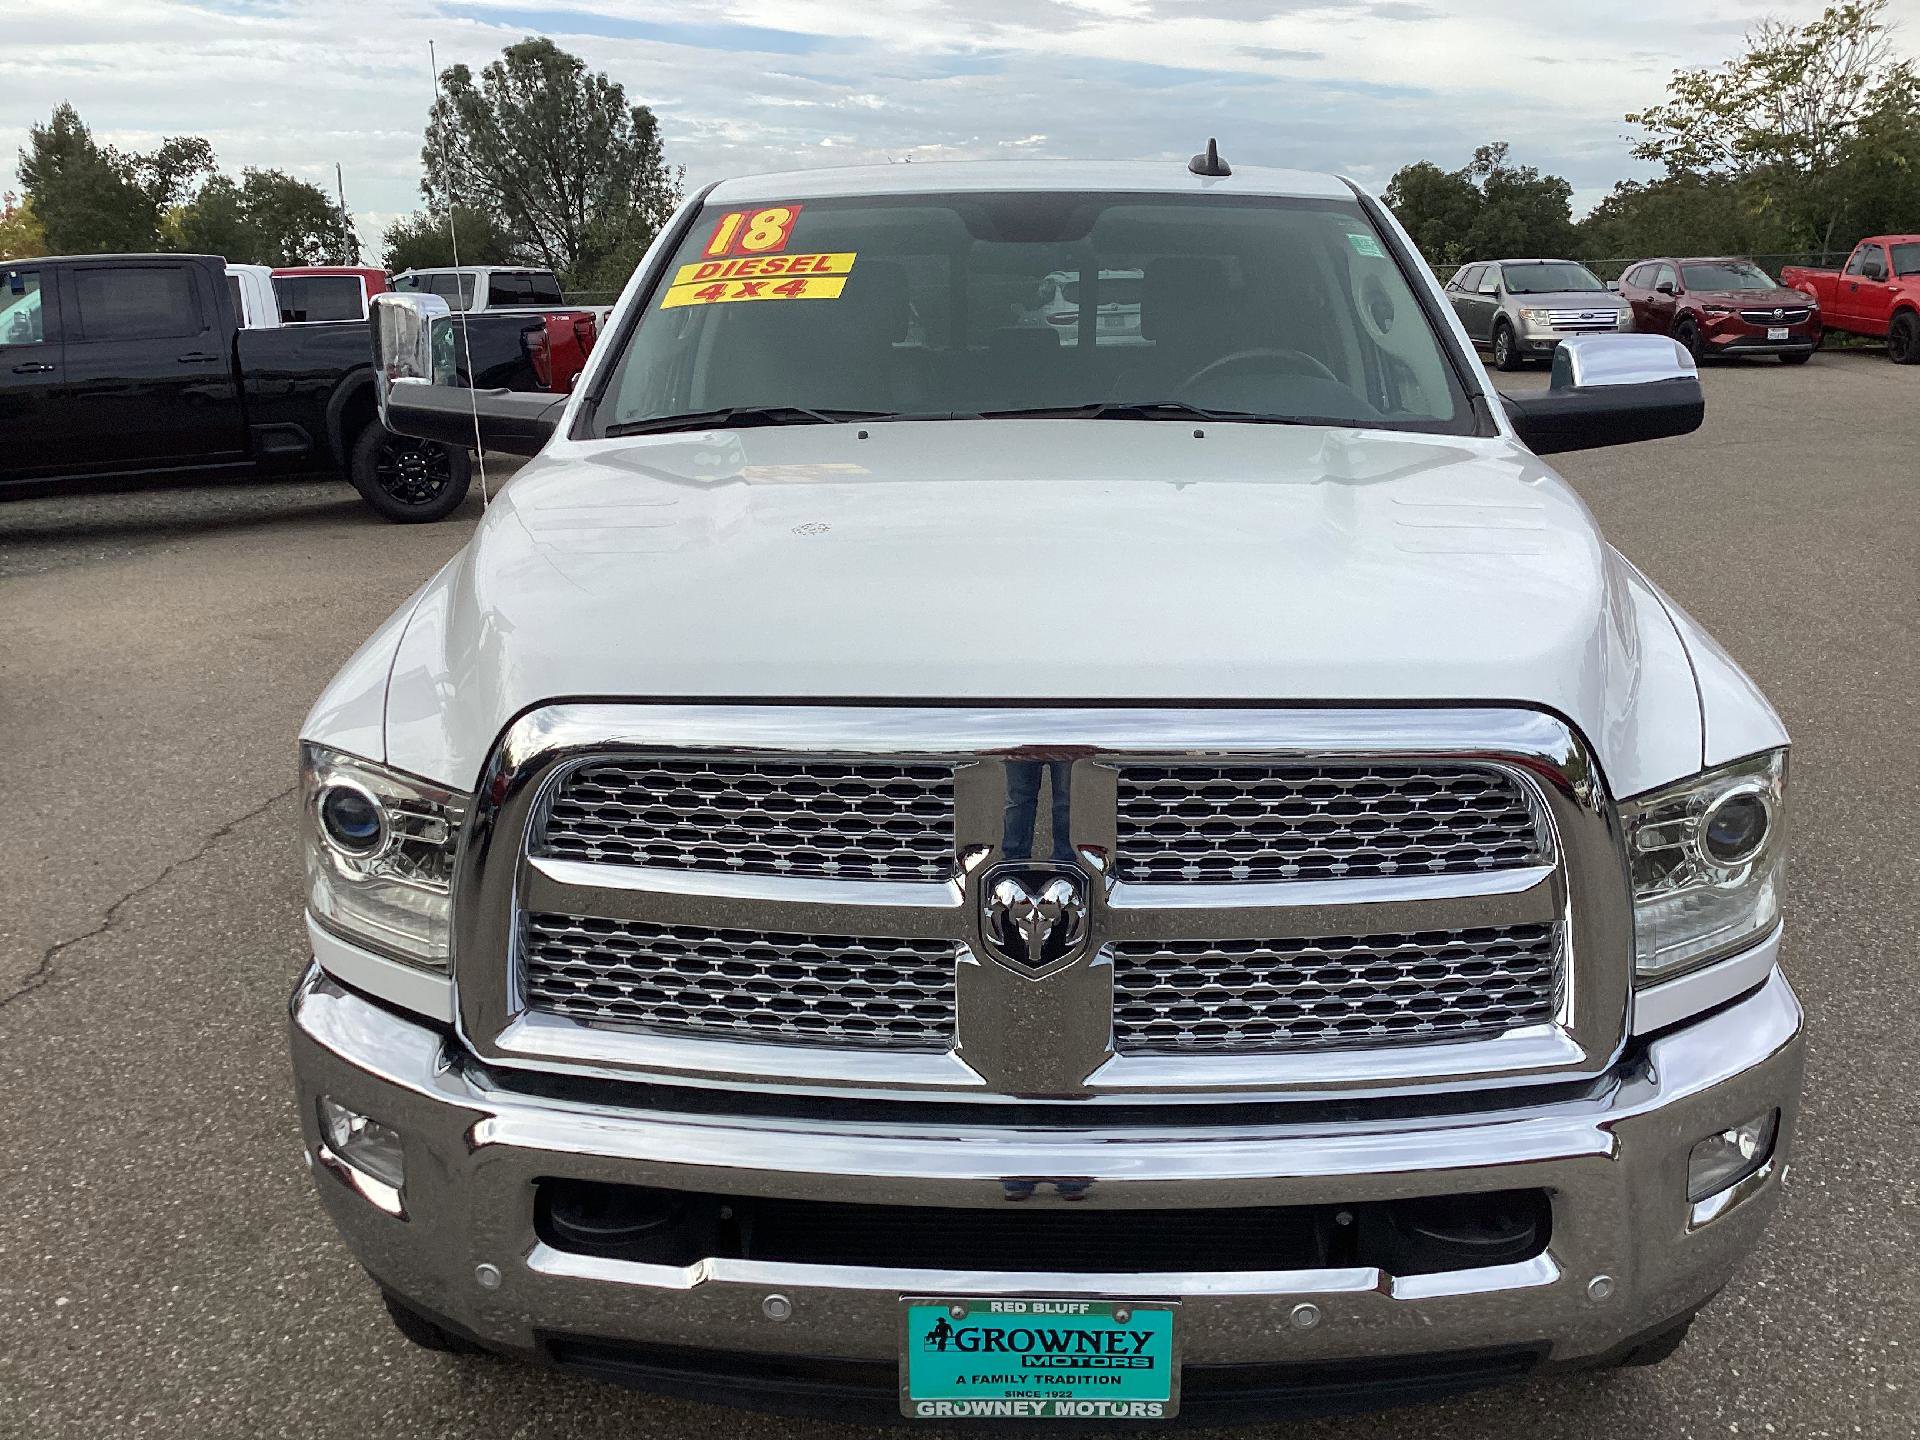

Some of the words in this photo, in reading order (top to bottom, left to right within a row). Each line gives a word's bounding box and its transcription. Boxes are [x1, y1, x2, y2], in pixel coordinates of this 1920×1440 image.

[707, 208, 792, 255] 18
[692, 255, 832, 280] DIESEL
[990, 1301, 1026, 1313] RED
[1032, 1303, 1090, 1314] BLUFF
[954, 1327, 1155, 1355] GROWNEY
[1025, 1356, 1151, 1368] MOTORS
[956, 1375, 967, 1385] A
[971, 1375, 1028, 1385] FAMILY
[1033, 1375, 1122, 1385] TRADITION
[1004, 1390, 1041, 1398] SINCE
[1046, 1390, 1073, 1398] 1922
[916, 1401, 1048, 1417] GROWNEY
[1055, 1401, 1163, 1417] MOTORS
